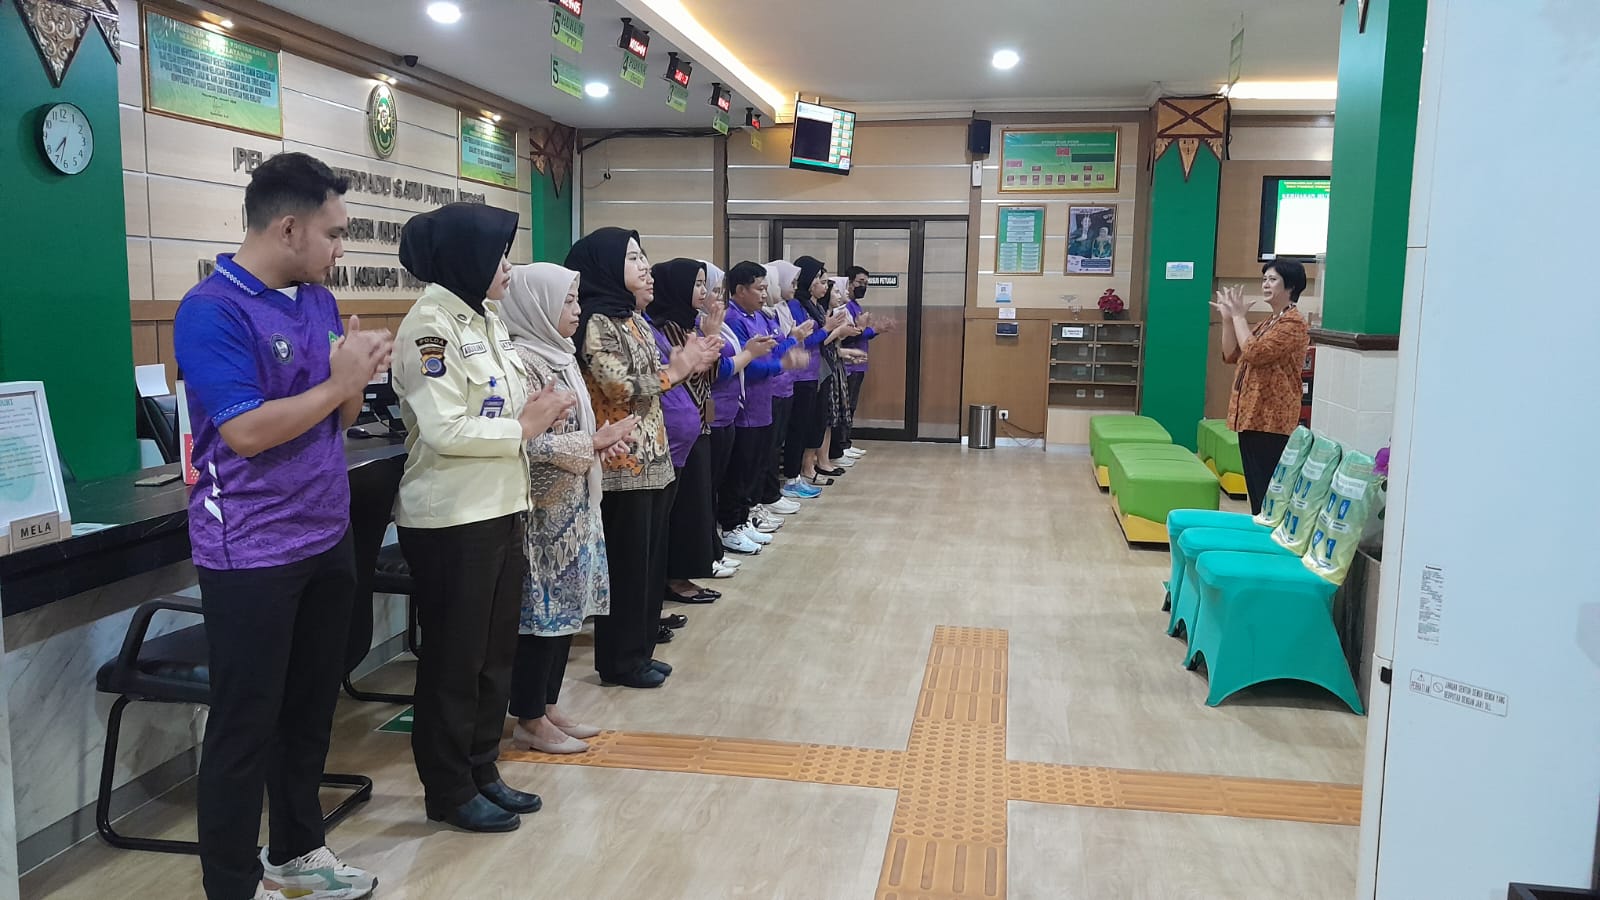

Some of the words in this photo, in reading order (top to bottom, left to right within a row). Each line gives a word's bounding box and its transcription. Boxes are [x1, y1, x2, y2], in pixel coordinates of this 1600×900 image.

[553, 11, 561, 35] 5
[623, 56, 629, 77] 4
[553, 60, 559, 84] 5
[52, 111, 58, 121] 11
[60, 109, 67, 119] 12
[45, 120, 52, 129] 10
[78, 124, 83, 135] 2
[81, 136, 86, 147] 3
[47, 145, 52, 155] 8
[78, 149, 83, 159] 4
[55, 154, 60, 164] 7
[63, 159, 69, 169] 6
[72, 157, 78, 167] 5
[350, 265, 399, 289] KORUPSI
[418, 337, 444, 346] POLDA
[20, 522, 52, 538] MELA
